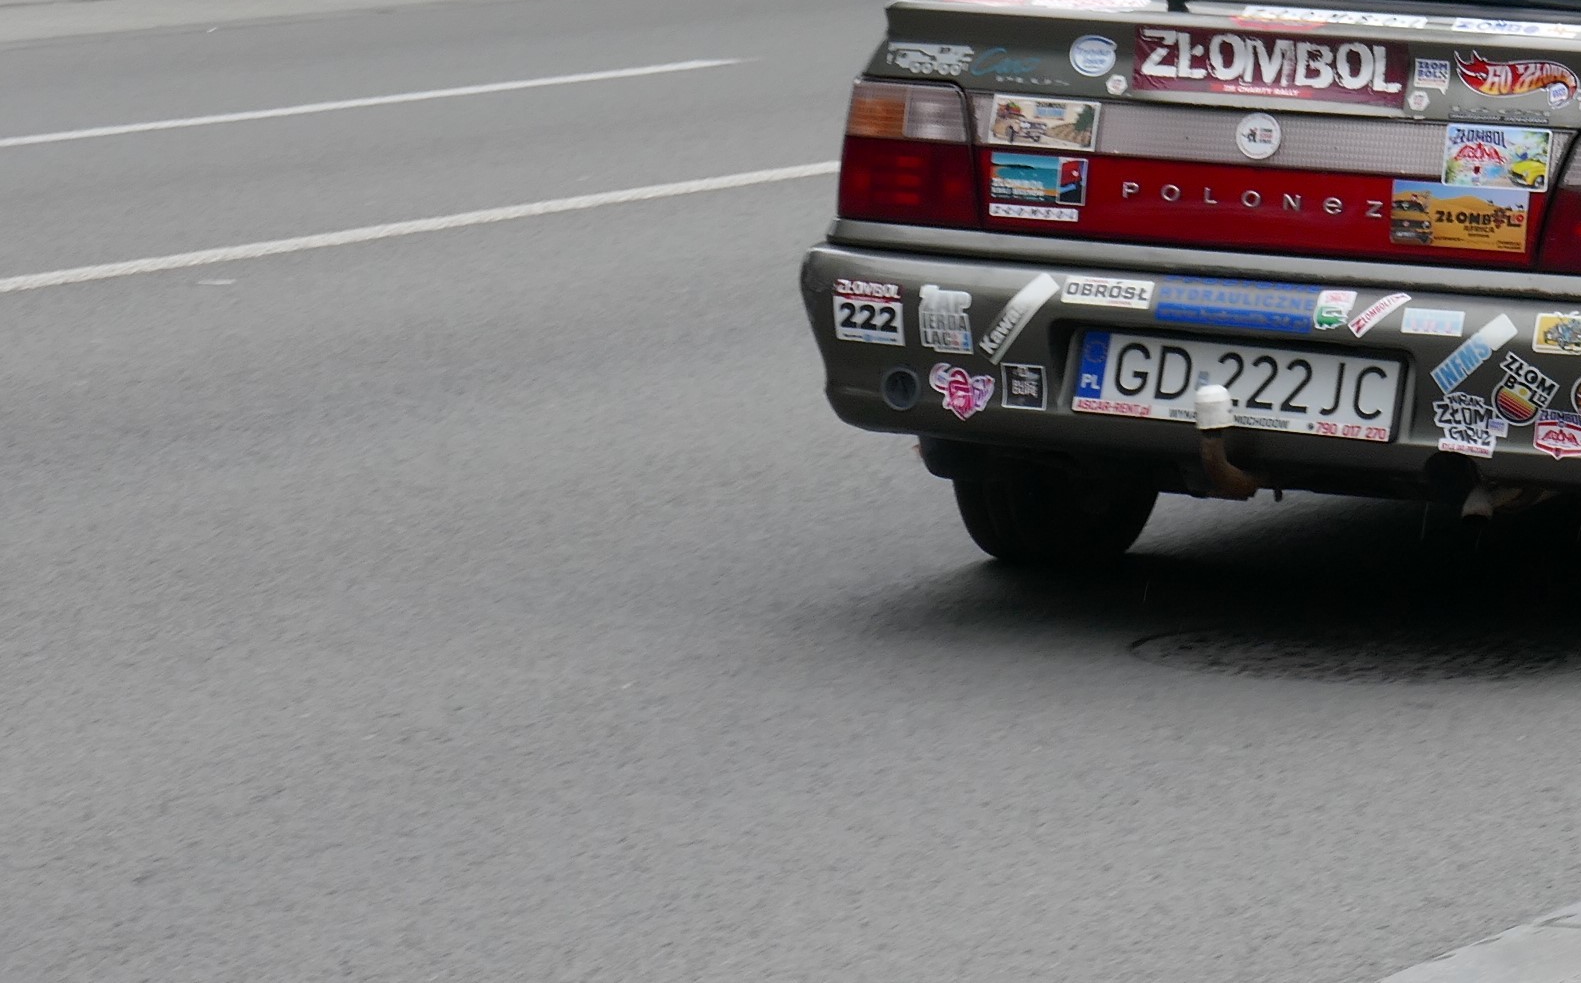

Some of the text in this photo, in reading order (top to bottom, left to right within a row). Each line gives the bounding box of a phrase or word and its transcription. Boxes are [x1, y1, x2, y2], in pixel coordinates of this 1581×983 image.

[1139, 25, 1403, 94] ZŁOMBOL
[840, 302, 898, 334] 222
[1080, 373, 1102, 392] PL
[1115, 343, 1193, 401] GD
[1218, 351, 1388, 421] 222JC
[1502, 354, 1558, 396] ZŁOM
[1315, 420, 1338, 436] 790
[1364, 425, 1388, 440] 270
